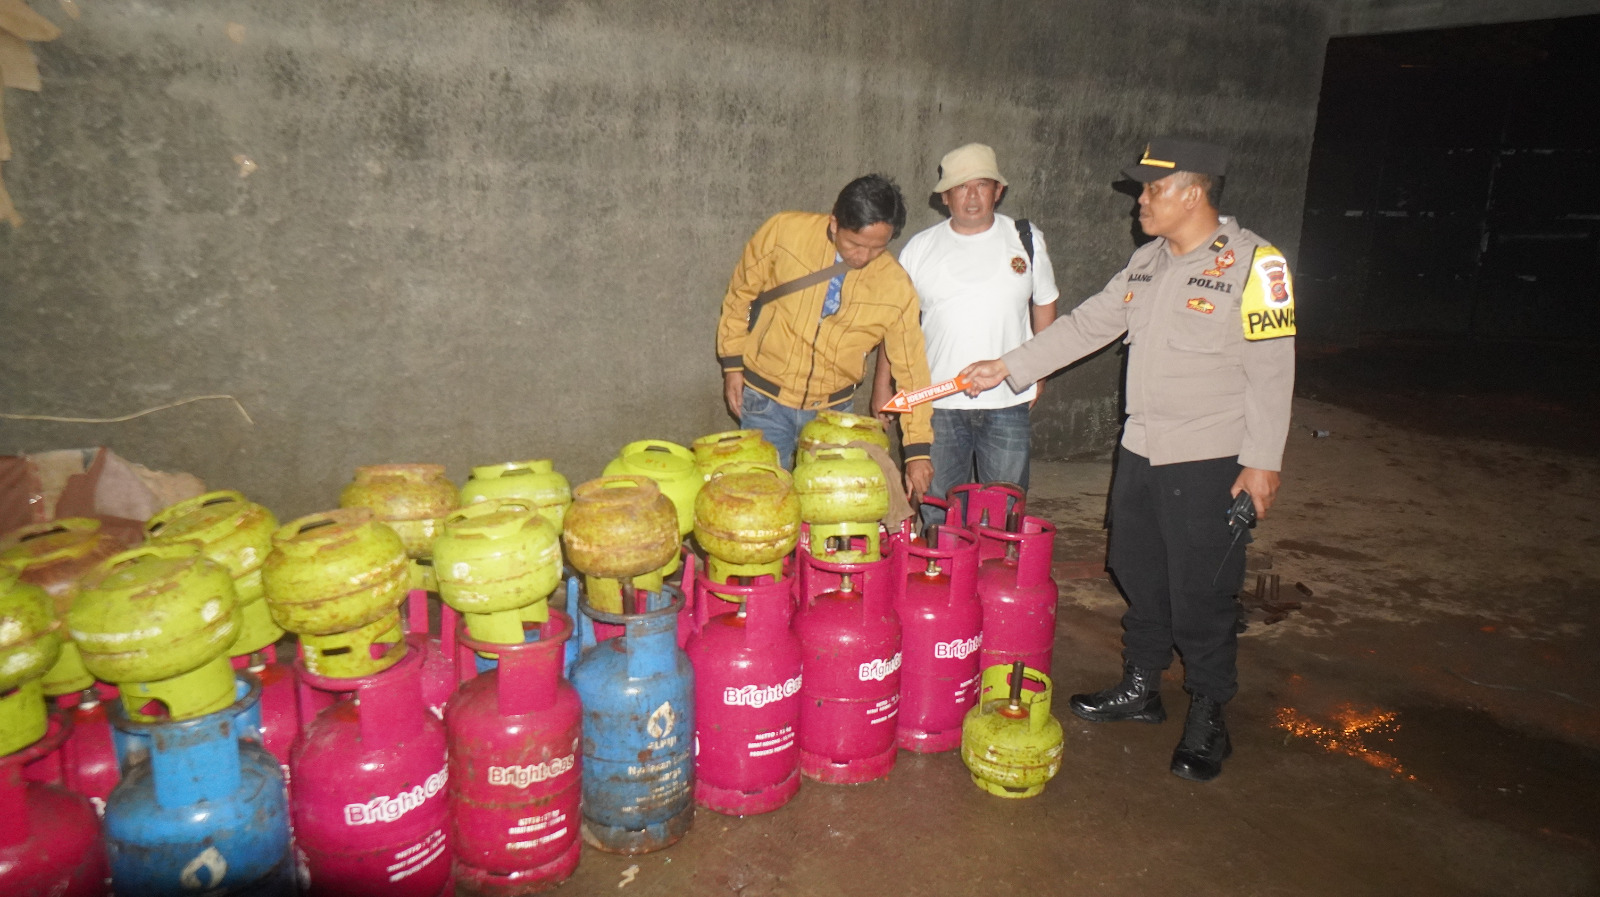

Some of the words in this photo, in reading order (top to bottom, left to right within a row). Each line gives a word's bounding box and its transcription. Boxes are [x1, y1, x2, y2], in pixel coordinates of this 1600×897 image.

[1187, 277, 1233, 294] POLRI
[906, 381, 955, 404] IDENTIFIKASI
[723, 684, 783, 709] Bright
[488, 762, 549, 789] Bright
[548, 753, 575, 778] Gas
[343, 784, 426, 826] Bright
